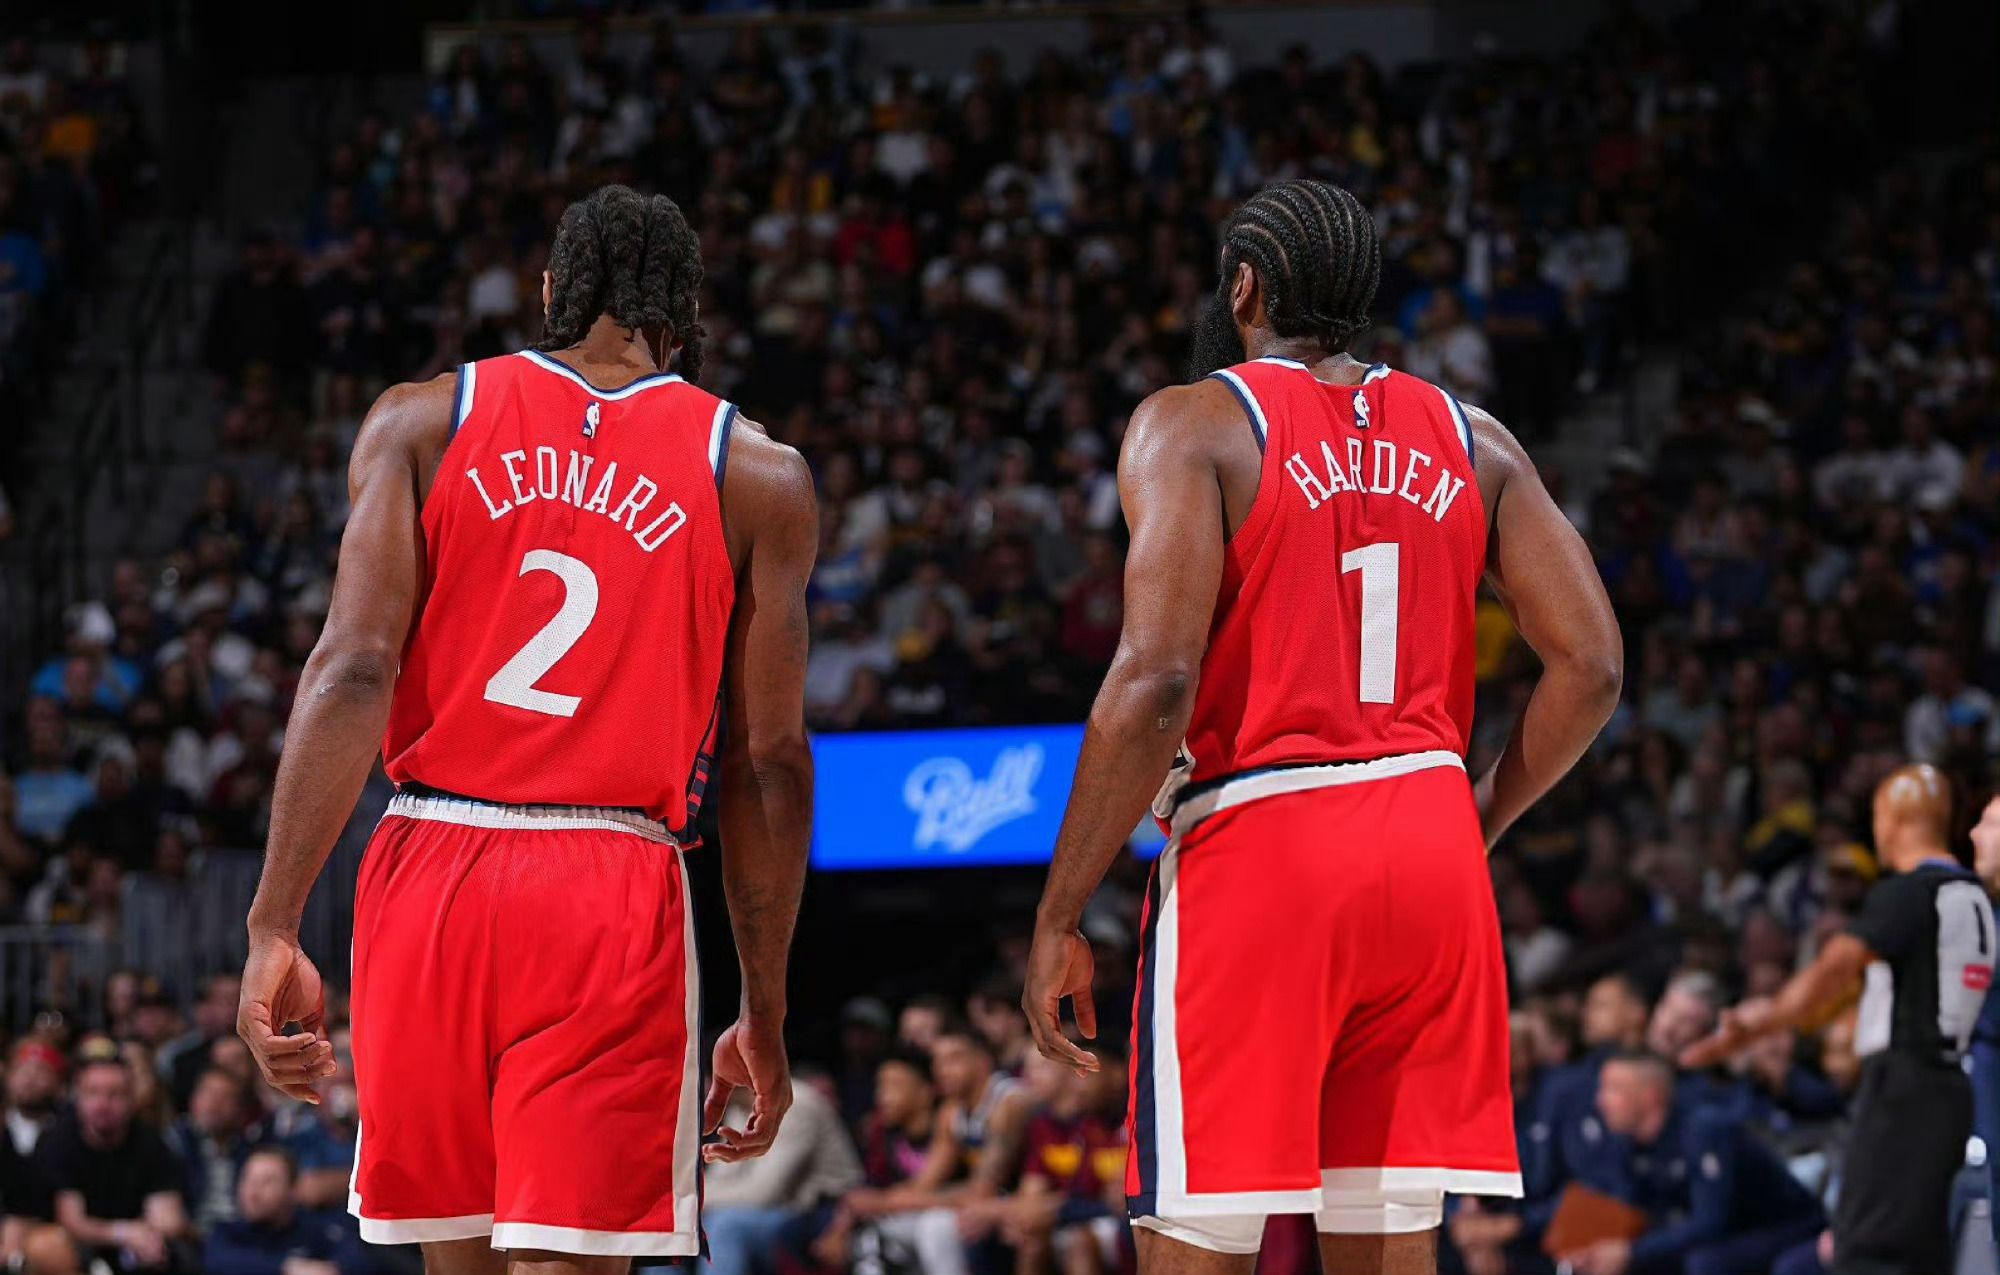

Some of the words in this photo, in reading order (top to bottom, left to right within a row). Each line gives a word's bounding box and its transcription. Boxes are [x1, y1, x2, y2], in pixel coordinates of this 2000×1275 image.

[466, 445, 687, 553] LEONARD
[1285, 438, 1466, 523] HARDEN
[483, 548, 599, 718] 2
[1341, 542, 1399, 704] 1
